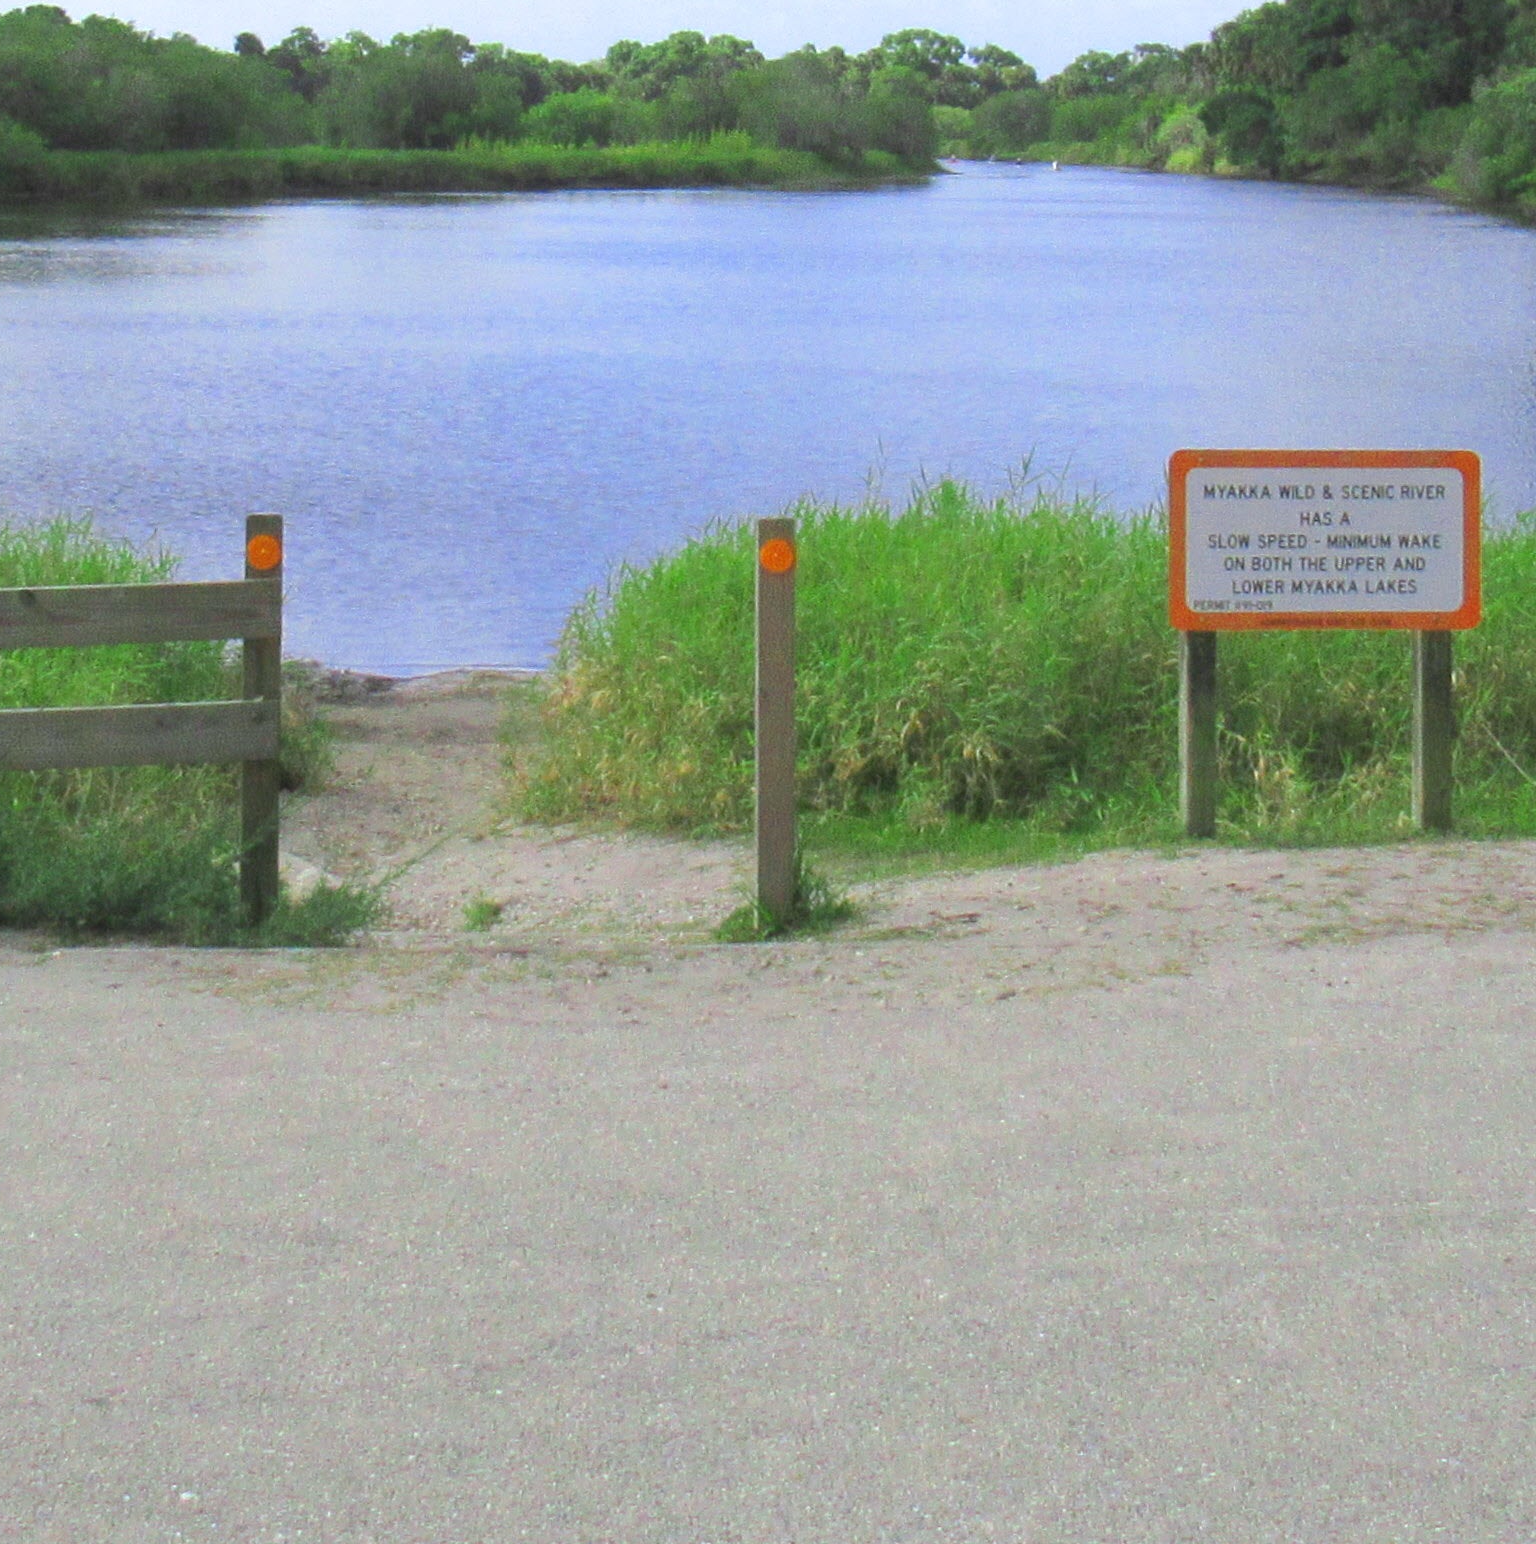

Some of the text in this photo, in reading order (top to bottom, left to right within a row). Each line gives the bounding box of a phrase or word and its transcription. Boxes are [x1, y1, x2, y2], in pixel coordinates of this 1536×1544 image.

[1204, 485, 1445, 499] MYAKKA WILD & SCENIC RIVER
[1300, 512, 1351, 526] HAS A
[1208, 535, 1250, 549] SLOW
[1258, 535, 1307, 549] SPEED
[1327, 535, 1391, 549] MINIMUM
[1398, 535, 1442, 549] WAKE
[1224, 557, 1426, 571] ON BOTH THE UPPER AND
[1232, 580, 1417, 594] LOWER MYAKKA LAKES
[1193, 600, 1231, 611] PERMIT
